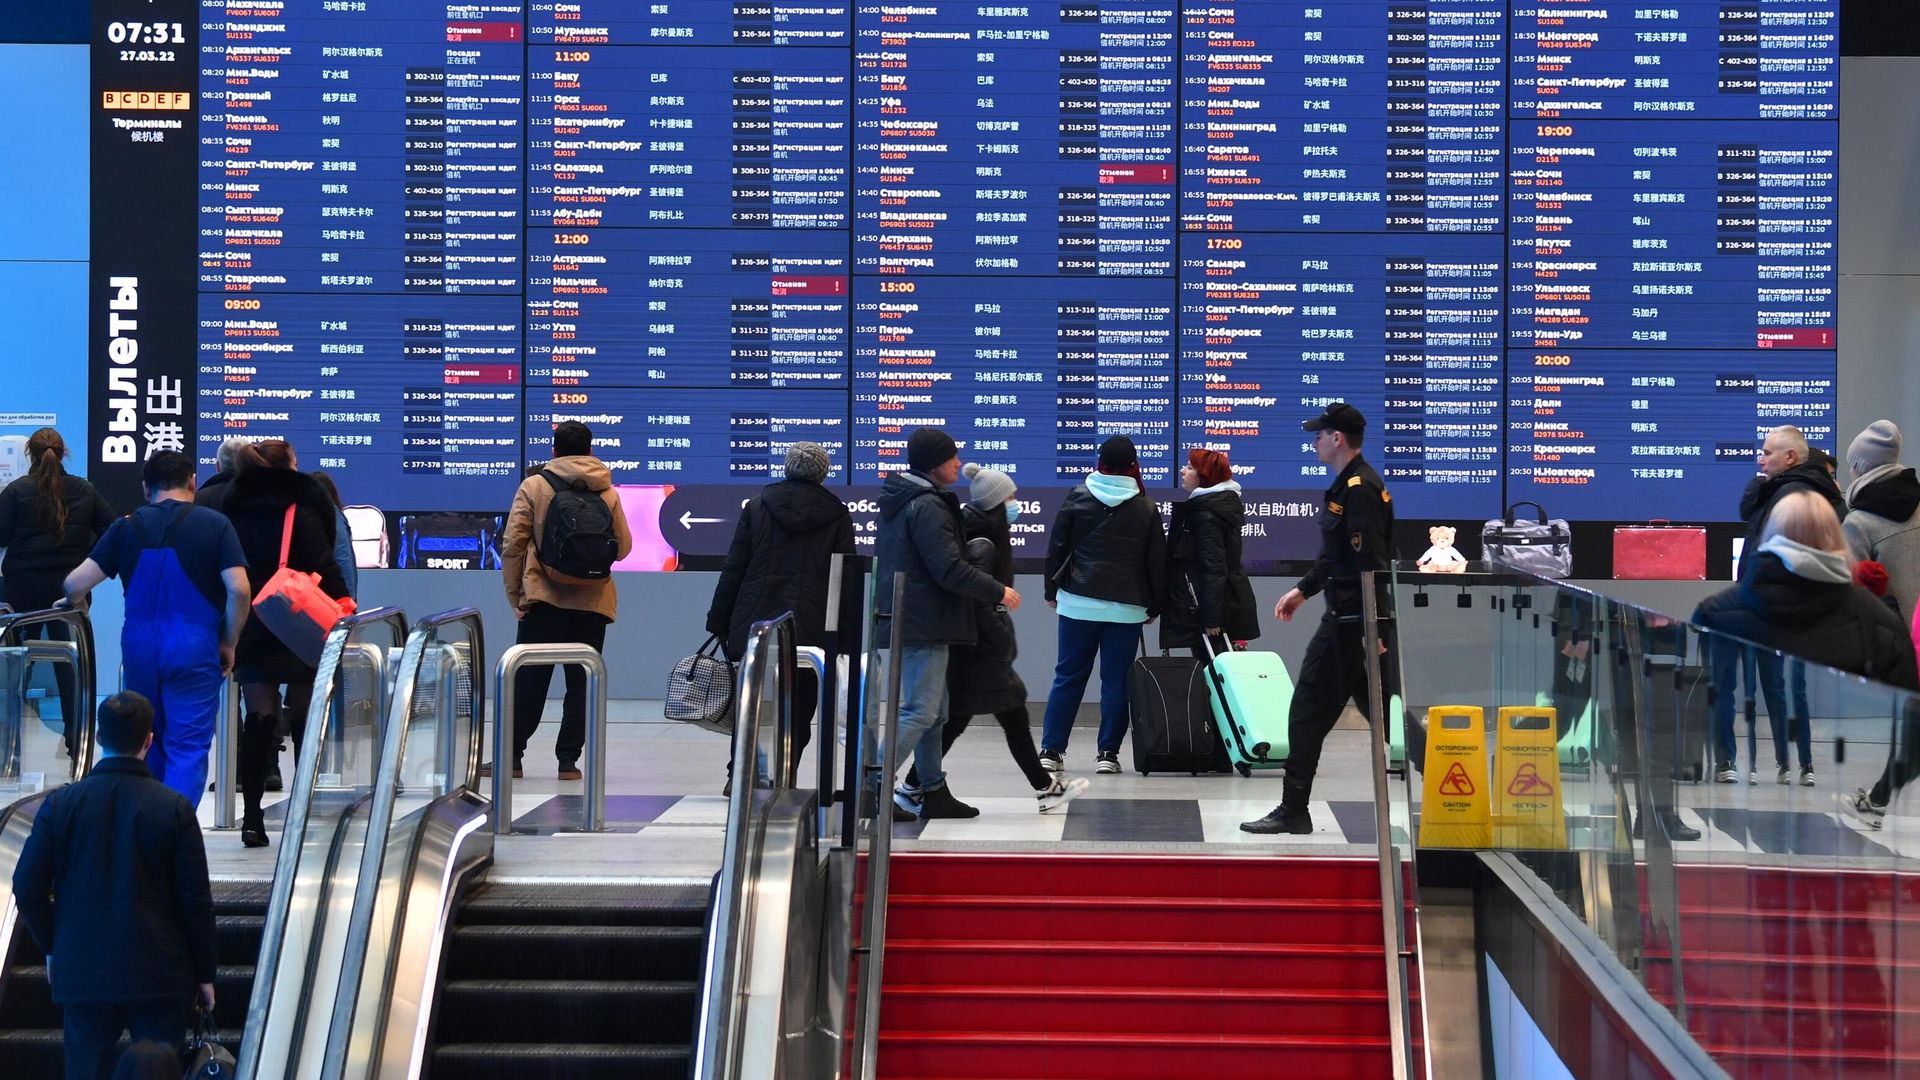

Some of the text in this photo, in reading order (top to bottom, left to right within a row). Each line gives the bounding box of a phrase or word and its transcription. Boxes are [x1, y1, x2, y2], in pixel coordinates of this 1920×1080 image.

[226, 0, 284, 8] Махачкала
[555, 3, 580, 12] Сочи
[881, 6, 937, 14] Челябинск
[1209, 8, 1234, 16] Сочи
[1538, 9, 1607, 19] Калининград
[108, 22, 185, 43] 07:31
[226, 23, 285, 32] Геленджик
[555, 26, 608, 37] Мурманск
[1208, 31, 1234, 39] Сочи
[1538, 32, 1598, 42] Н.Новгород
[226, 46, 291, 55] Архангельск
[447, 50, 480, 58] Посадка
[120, 51, 175, 61] 27.03.22
[556, 52, 589, 61] 11:00
[1208, 54, 1273, 64] Архангельск
[1537, 55, 1571, 63] Минск
[226, 69, 278, 78] Мин.Воды
[554, 72, 579, 82] Баку
[881, 75, 905, 85] Баку
[1208, 77, 1265, 85] Махачкала
[1537, 78, 1626, 88] Санкт-Петербург
[106, 94, 182, 104] B C D E F
[226, 91, 271, 101] Грозный
[554, 95, 580, 105] Орск
[880, 97, 901, 108] Уфа
[1208, 99, 1259, 109] Мин.Воды
[1536, 101, 1602, 111] Архангельск
[225, 114, 267, 123] Тюмень
[554, 118, 625, 128] Екатеринбург
[112, 118, 182, 130] Терминалы
[881, 120, 937, 130] Чебоксары
[1208, 122, 1276, 132] Калининград
[1538, 127, 1572, 135] 19:00
[131, 131, 164, 142] 候机楼
[226, 137, 251, 145] Сочи
[554, 141, 642, 151] Санкт-Петербург
[881, 143, 947, 151] Нижнекамск
[1207, 145, 1249, 155] Саратов
[1536, 147, 1595, 156] Череповец
[226, 160, 314, 170] Санкт-Петербург
[554, 163, 603, 173] Салехард
[880, 166, 914, 174] Минск
[1207, 168, 1247, 176] Ижевск
[1537, 170, 1562, 178] Сочи
[226, 183, 259, 191] Минск
[553, 186, 642, 196] Санкт-Петербург
[880, 189, 941, 199] Ставрополь
[1536, 192, 1592, 201] Челябинск
[225, 206, 283, 216] Сыктывкар
[553, 209, 602, 219] Абу-Даби
[880, 212, 947, 221] Владикавказ
[1536, 215, 1572, 224] Казань
[225, 229, 283, 237] Махачкала
[555, 235, 588, 243] 12:00
[879, 235, 933, 245] Астрахань
[1208, 240, 1242, 248] 17:00
[1535, 238, 1571, 248] Якутск
[226, 252, 251, 261] Сочи
[553, 255, 606, 264] Астрахань
[880, 257, 934, 267] Волгоград
[1206, 260, 1245, 270] Самара
[1536, 261, 1597, 271] Красноярск
[225, 274, 286, 284] Ставрополь
[553, 277, 597, 288] Нальчик
[772, 281, 806, 289] Отменен
[881, 283, 914, 292] 15:00
[1206, 282, 1296, 291] Южно-Сахалинск
[1535, 284, 1590, 292] Ульяновск
[224, 300, 260, 309] 09:00
[553, 300, 578, 308] Сочи
[879, 303, 918, 313] Самара
[1206, 305, 1294, 315] Санкт-Петербург
[1535, 307, 1580, 316] Магадан
[225, 320, 277, 330] Мин.Воды
[552, 323, 576, 331] Ухта
[879, 326, 913, 336] Пермь
[1205, 328, 1261, 338] Хабаровск
[1534, 330, 1583, 340] Улан-Удэ
[225, 343, 293, 353] Новосибирск
[552, 346, 596, 354] Апатиты
[879, 349, 936, 359] Махачкала
[1206, 351, 1247, 360] Иркутск
[1535, 356, 1570, 365] 20:00
[102, 277, 138, 462] Вылеты
[224, 366, 256, 374] Пенза
[445, 370, 479, 378] Отменен
[552, 369, 589, 377] Казань
[879, 371, 952, 381] Магнитогорск
[1205, 373, 1226, 383] Уфа
[1535, 376, 1604, 386] Калининград
[224, 389, 313, 399] Санкт-Петербург
[553, 394, 587, 403] 13:00
[879, 394, 932, 404] Мурманск
[1206, 396, 1276, 406] Екатеринбург
[1534, 399, 1561, 408] Дели
[1205, 419, 1259, 429] Мурманск
[1534, 422, 1568, 430] Минск
[1204, 442, 1230, 451] Доха
[1534, 445, 1595, 455] Красноярск
[1534, 468, 1595, 478] Н.Новгород
[1242, 502, 1319, 517] 以自助值机，
[1010, 524, 1045, 533] аться
[1010, 538, 1026, 546] он
[427, 558, 469, 569] SPORT
